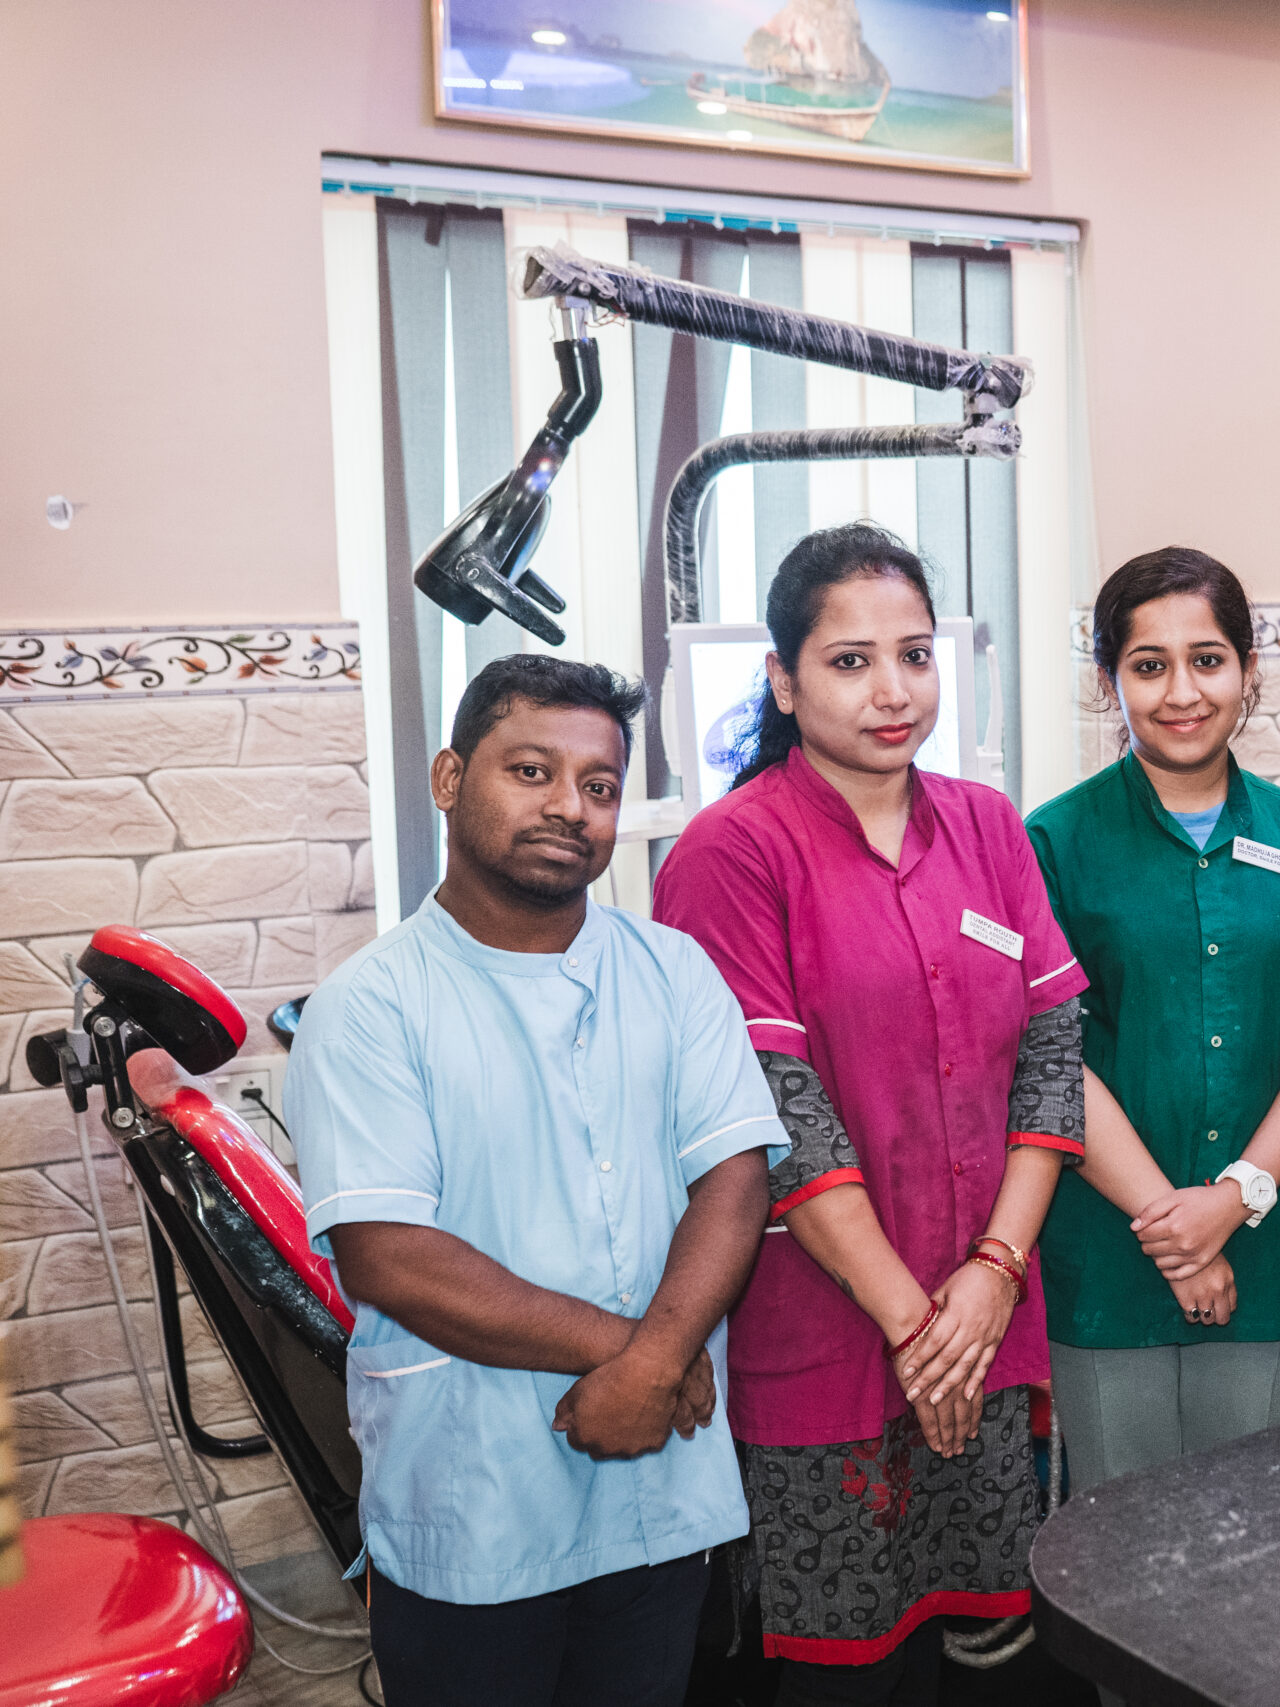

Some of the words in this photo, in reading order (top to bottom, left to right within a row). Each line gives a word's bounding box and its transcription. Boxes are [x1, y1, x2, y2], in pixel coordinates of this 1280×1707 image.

[1246, 844, 1270, 857] MADHUJA
[970, 914, 992, 929] TUMPA
[993, 926, 1017, 942] ROUTH
[970, 920, 988, 934] DENTAL
[988, 930, 1016, 947] ASSISTANT
[972, 929, 988, 940] SMILE
[989, 936, 1000, 945] FOR
[1000, 943, 1011, 951] ALL
